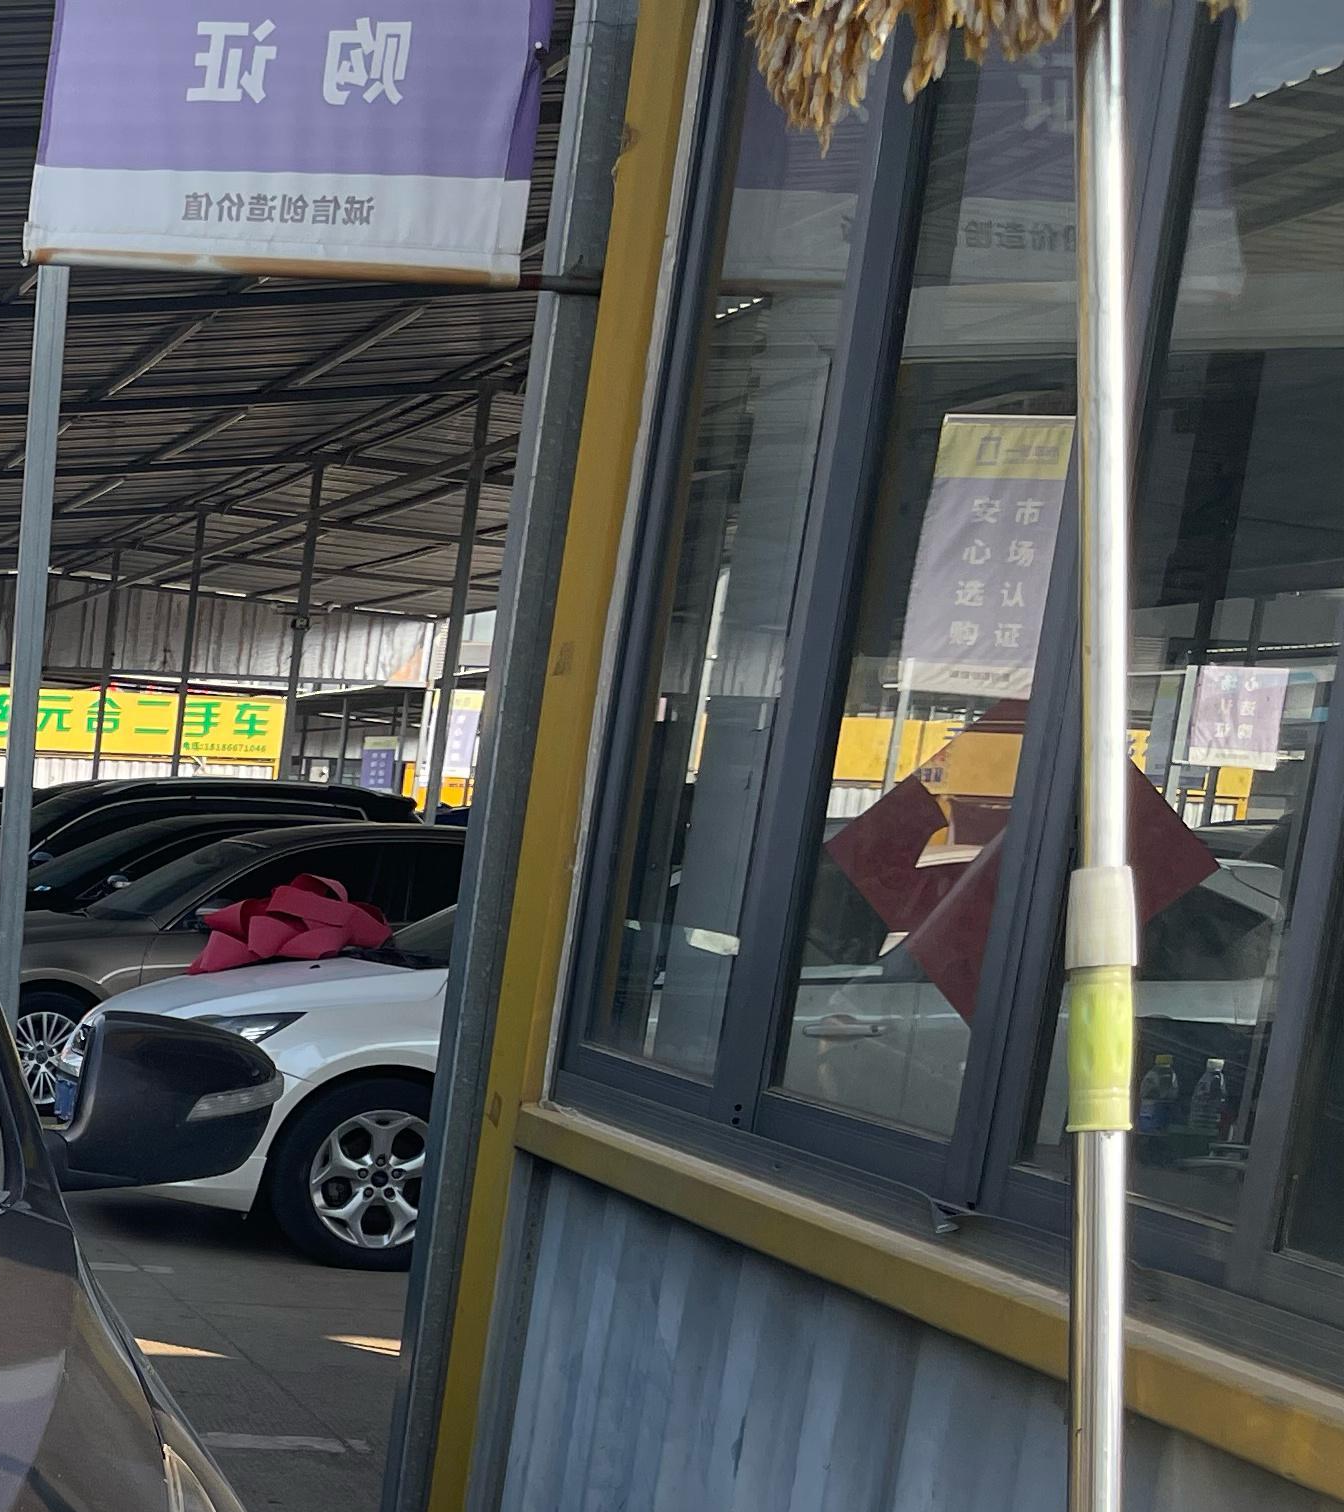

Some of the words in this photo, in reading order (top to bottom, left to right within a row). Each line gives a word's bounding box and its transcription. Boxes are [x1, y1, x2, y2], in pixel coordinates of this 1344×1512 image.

[37, 694, 272, 739] 元合二手车
